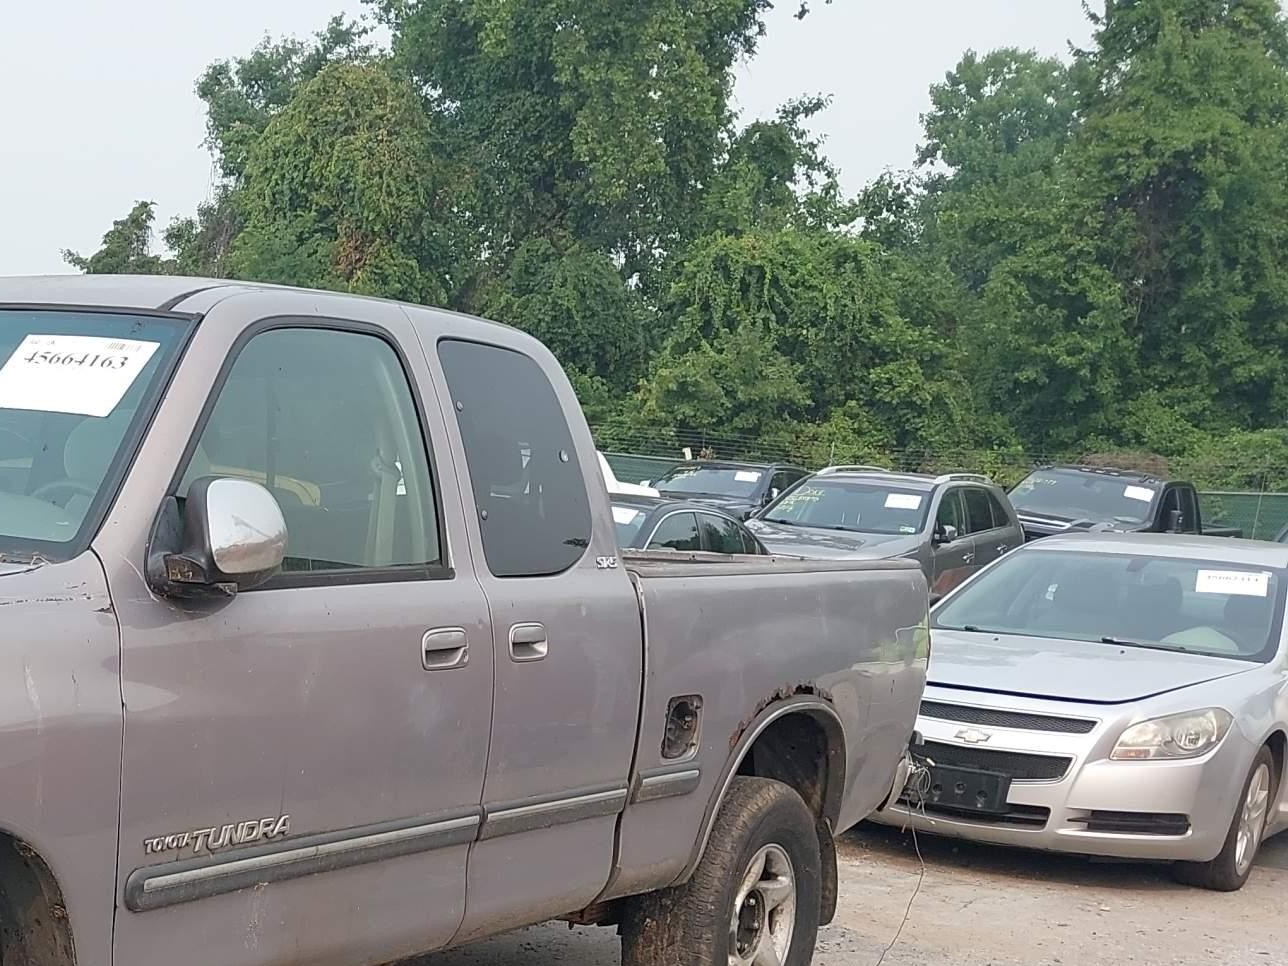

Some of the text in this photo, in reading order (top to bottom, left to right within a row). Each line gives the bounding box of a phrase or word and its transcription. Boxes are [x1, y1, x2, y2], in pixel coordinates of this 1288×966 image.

[23, 351, 130, 370] 45664163
[144, 814, 291, 855] TOYOTA TUNDRA
